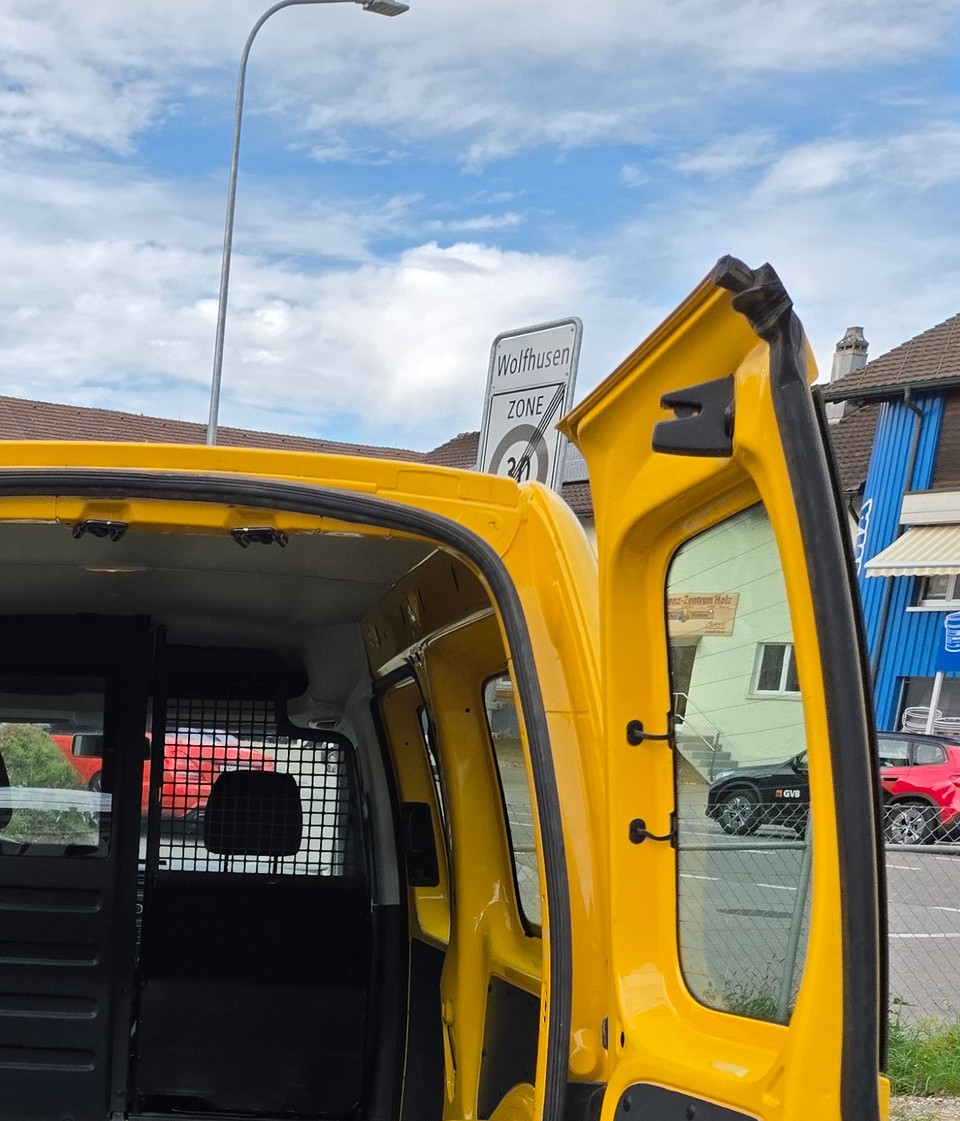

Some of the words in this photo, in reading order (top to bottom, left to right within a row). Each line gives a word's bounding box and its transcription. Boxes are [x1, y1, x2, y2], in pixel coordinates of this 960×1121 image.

[497, 347, 570, 377] Wolfhusen
[507, 396, 544, 419] ZONE
[715, 595, 732, 605] Holz
[783, 790, 800, 798] GVB
